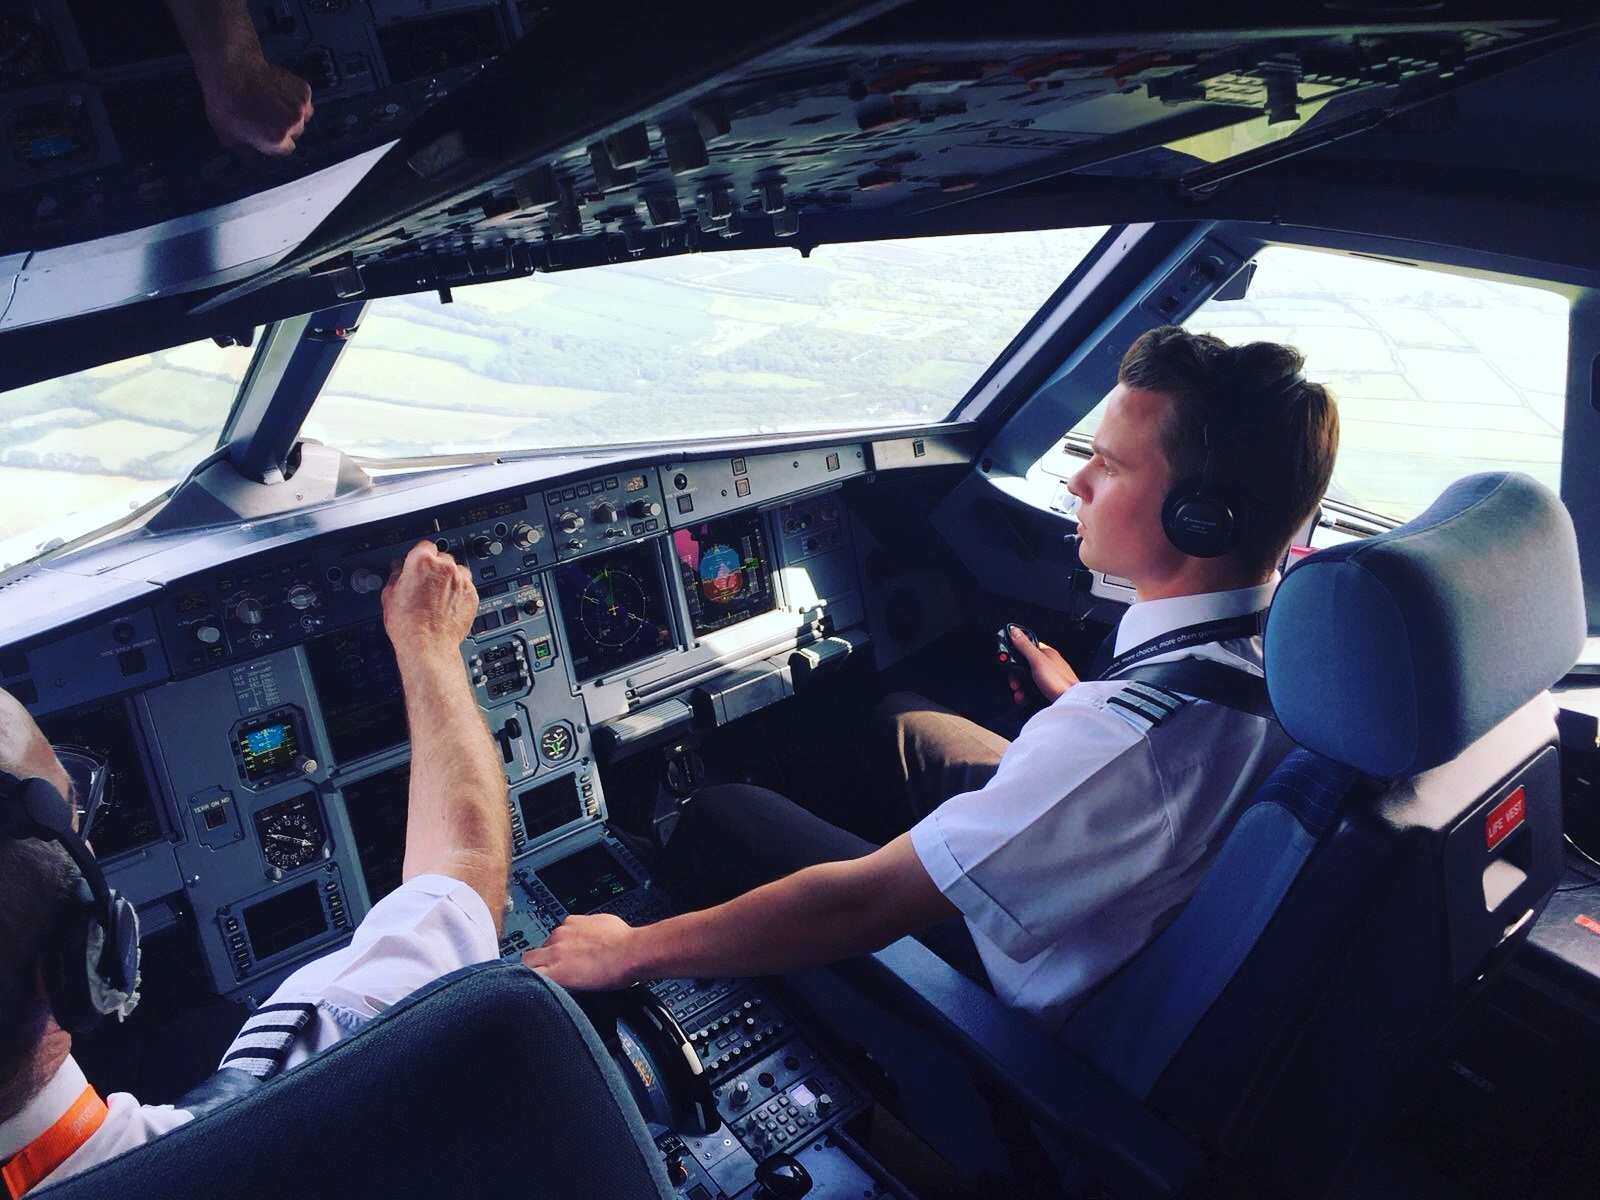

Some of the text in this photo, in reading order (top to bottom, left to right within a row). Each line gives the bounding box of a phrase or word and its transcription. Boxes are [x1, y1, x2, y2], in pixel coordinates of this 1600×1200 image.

[1159, 639, 1176, 649] more
[1176, 632, 1197, 643] often
[210, 800, 220, 808] ON
[1488, 799, 1522, 838] LIFE VEST
